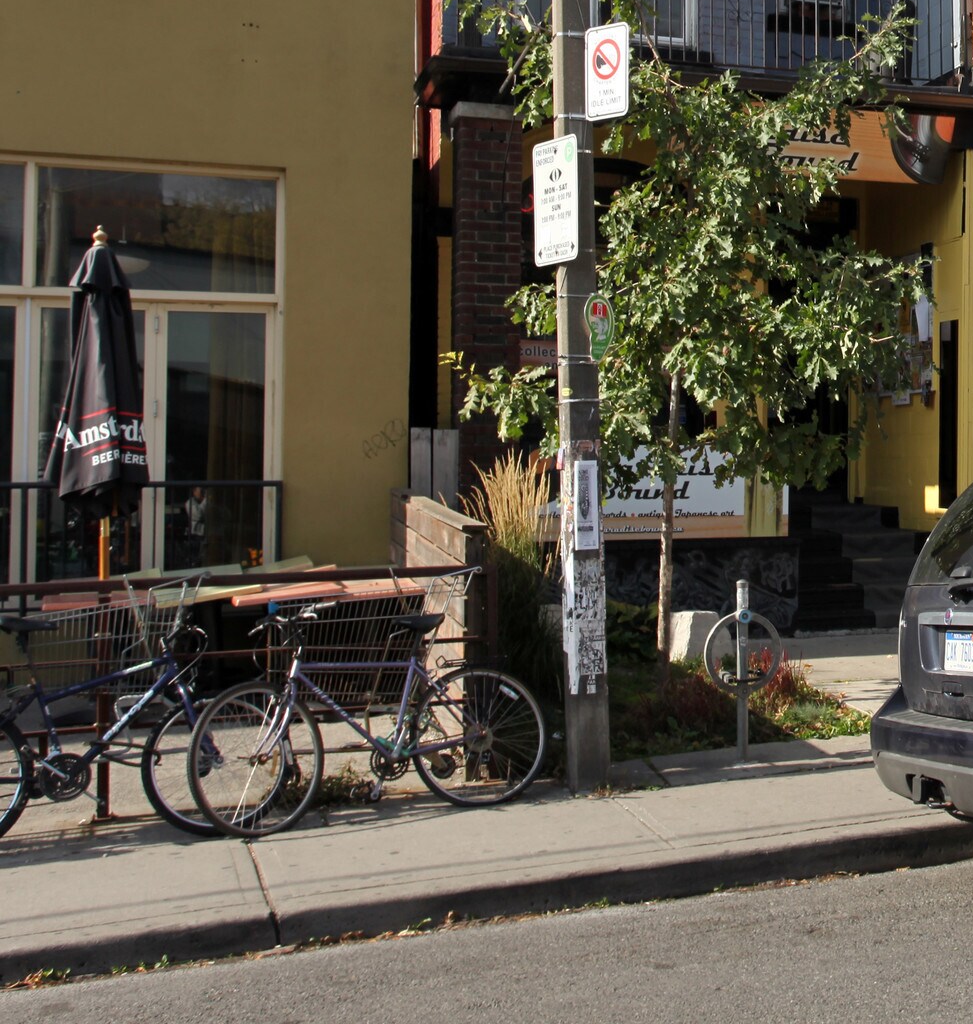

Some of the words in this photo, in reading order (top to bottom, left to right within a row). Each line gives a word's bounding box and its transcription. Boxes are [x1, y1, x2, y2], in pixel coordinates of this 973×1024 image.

[591, 99, 604, 108] IDLE
[606, 96, 622, 106] LIMIT
[544, 187, 555, 195] MON
[559, 183, 568, 192] SAT
[551, 203, 562, 212] SUN
[92, 449, 121, 466] BEER
[674, 509, 719, 518] Japanese
[721, 509, 735, 517] art
